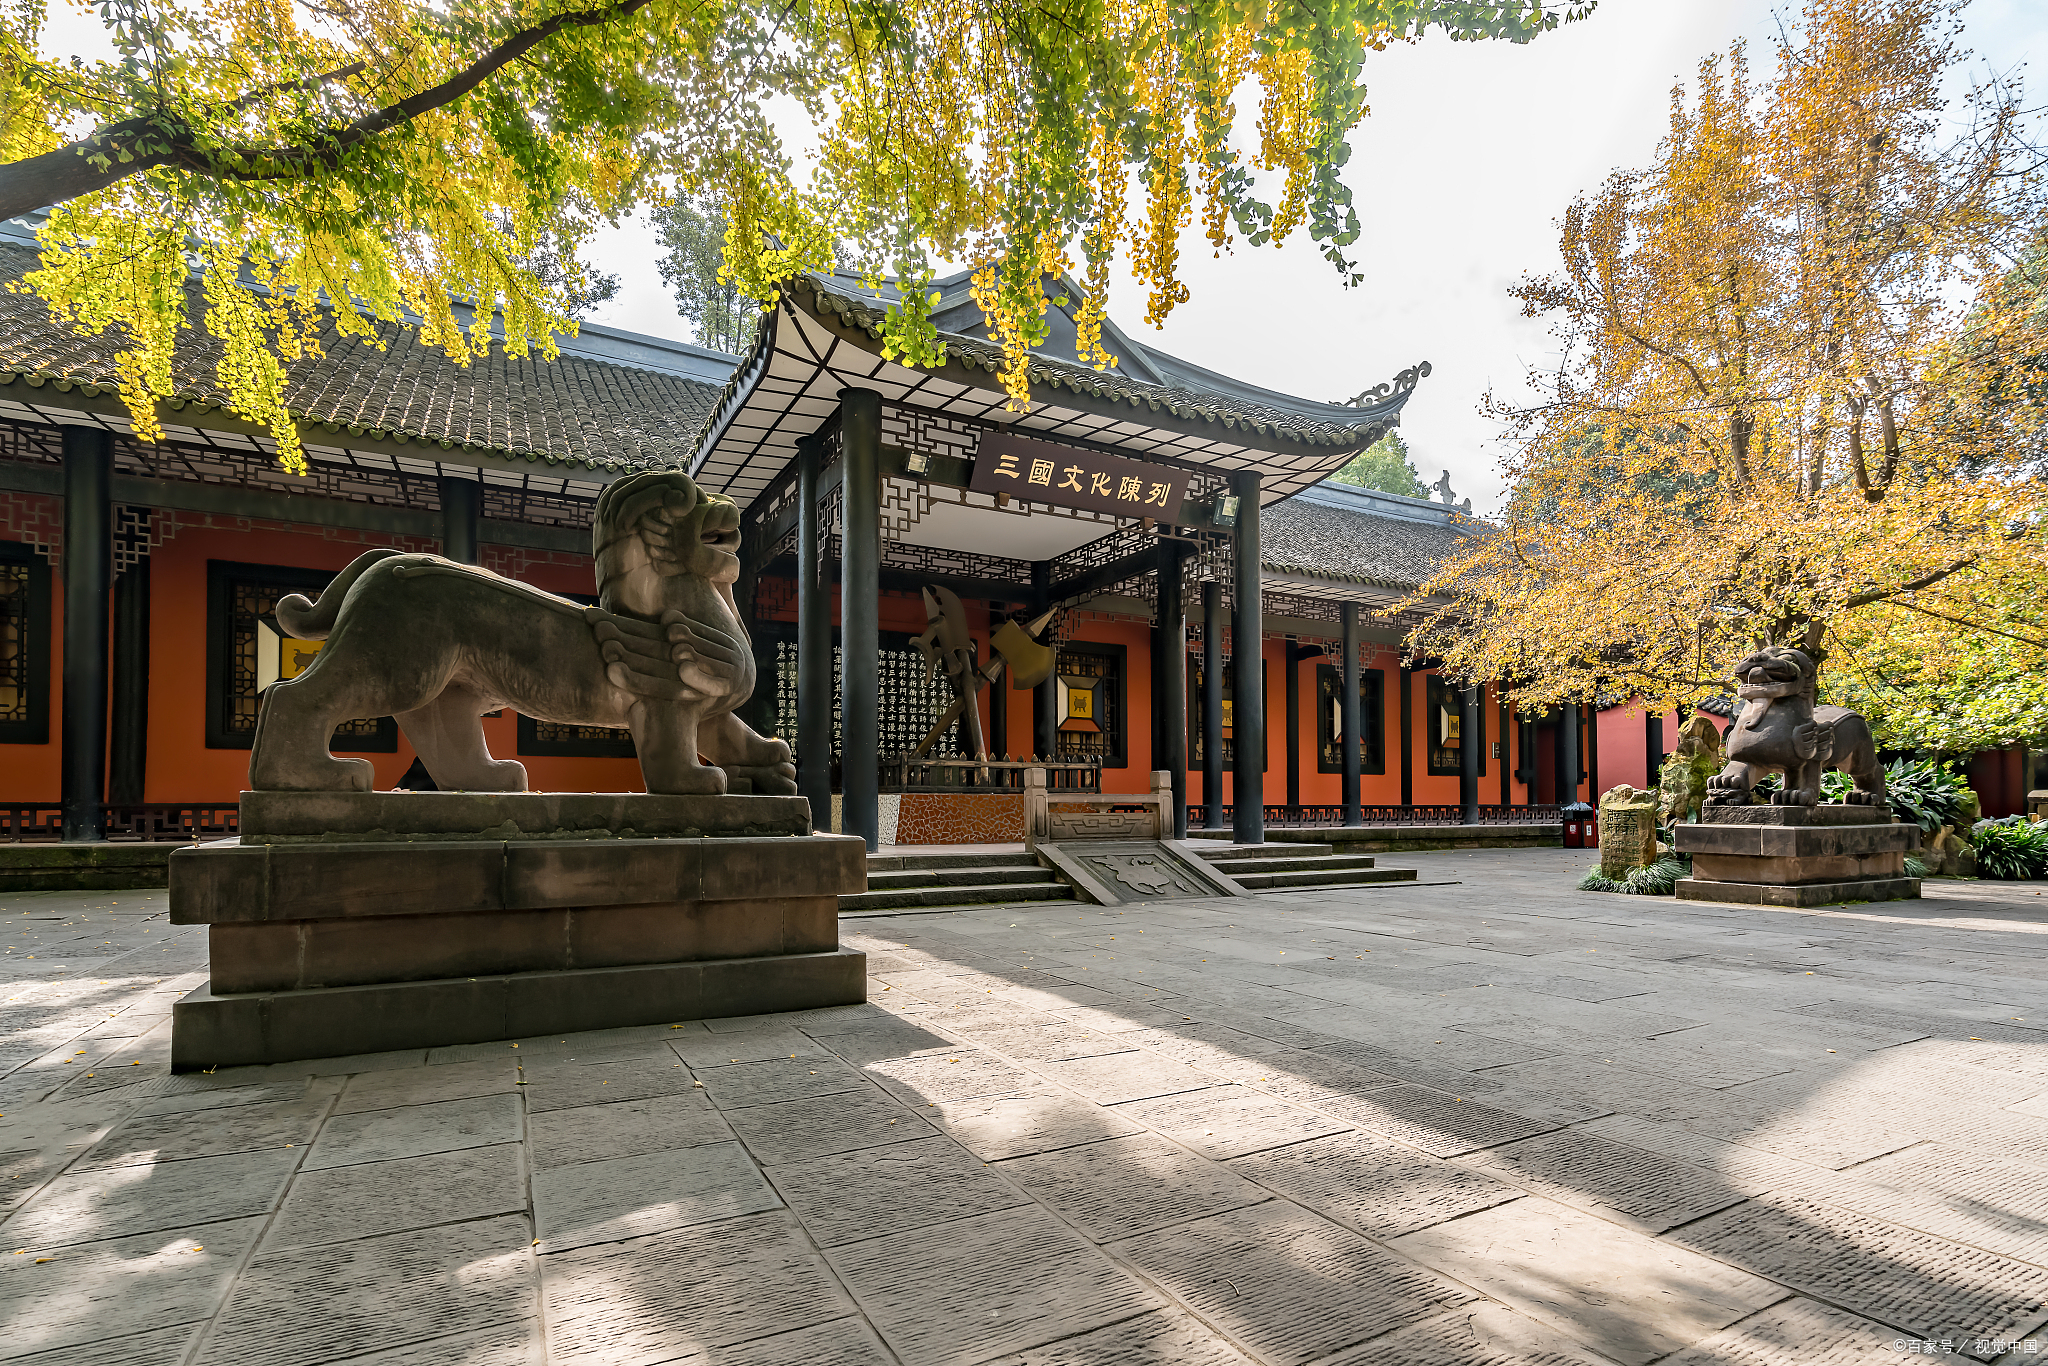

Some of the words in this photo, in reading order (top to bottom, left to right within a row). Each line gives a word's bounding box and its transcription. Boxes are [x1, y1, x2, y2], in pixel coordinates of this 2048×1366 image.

[993, 454, 1171, 507] 三國文化陳列
